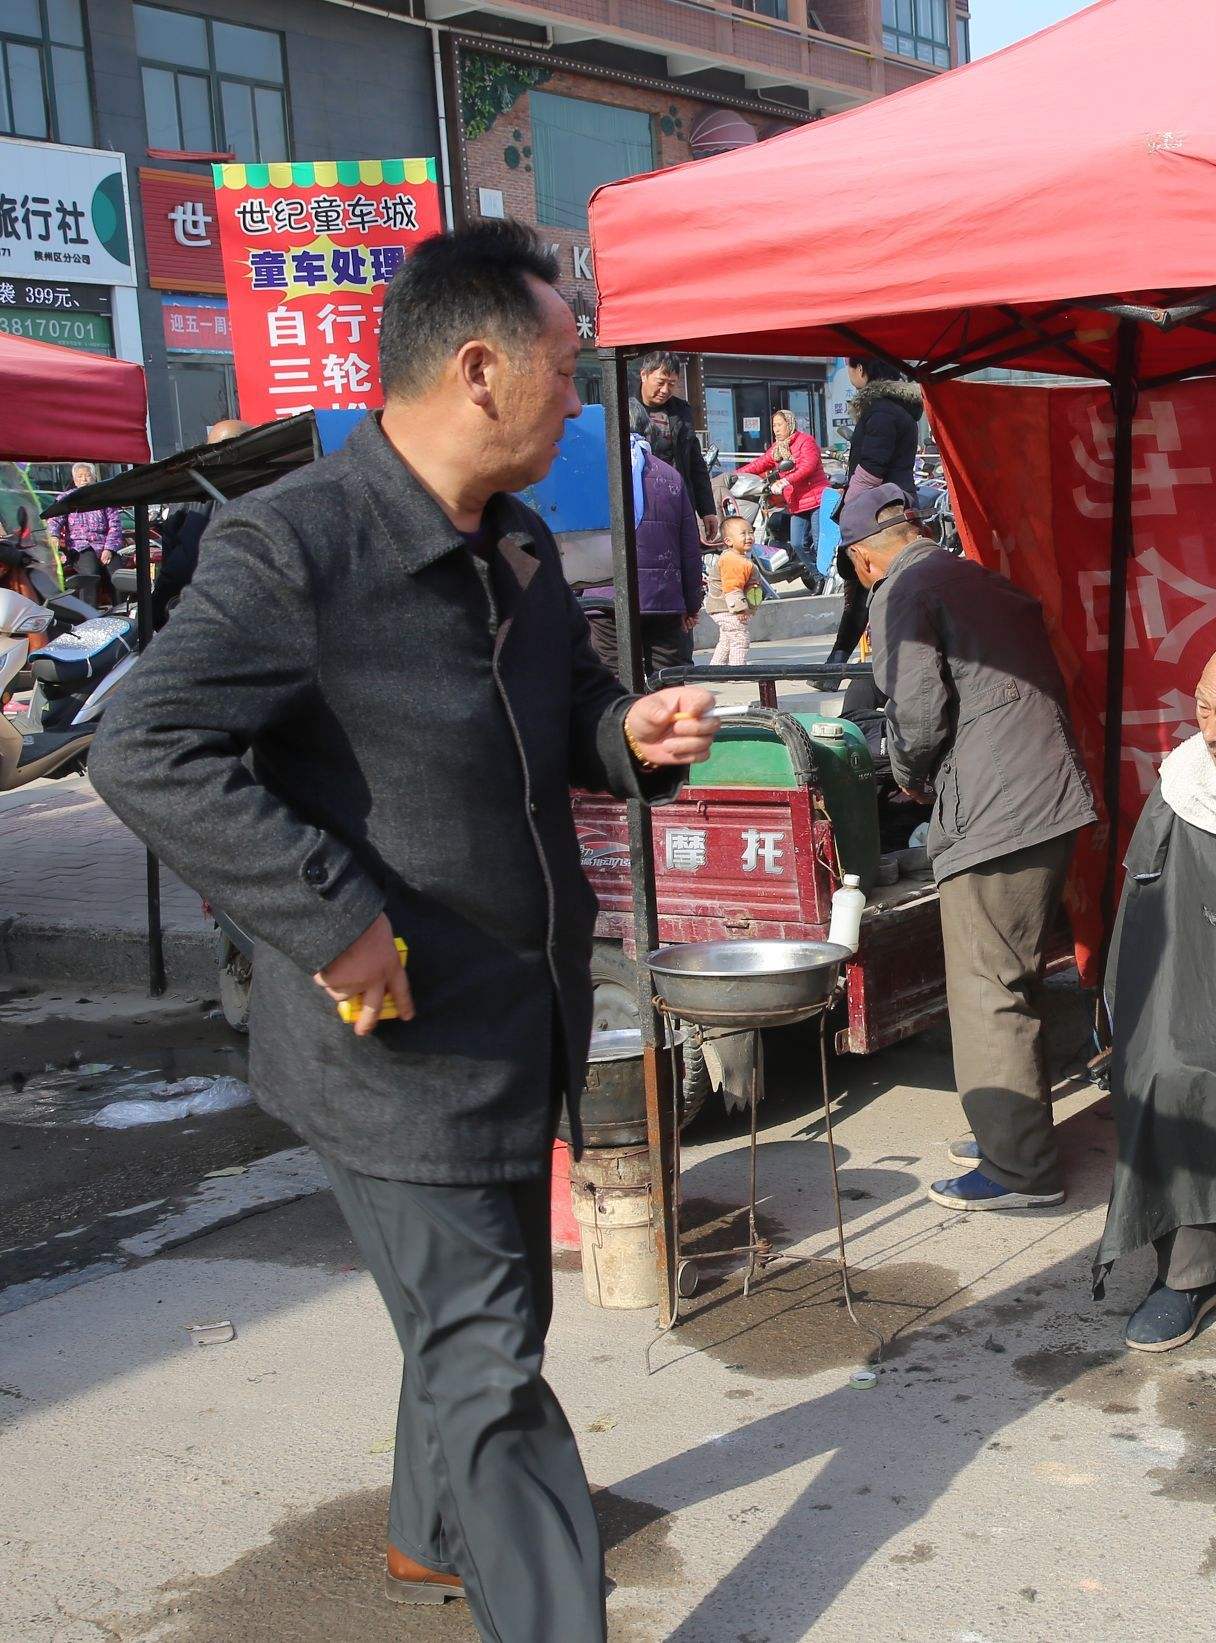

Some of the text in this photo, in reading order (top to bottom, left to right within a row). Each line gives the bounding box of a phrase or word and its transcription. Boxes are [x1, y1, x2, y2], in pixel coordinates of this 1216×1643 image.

[168, 202, 213, 247] 世
[236, 195, 418, 235] 世纪童车城
[250, 247, 405, 289] 童车处理
[170, 313, 232, 336] 迎五一周
[267, 303, 384, 347] 自行
[268, 352, 382, 395] 三轮
[665, 826, 784, 875] 摩托
